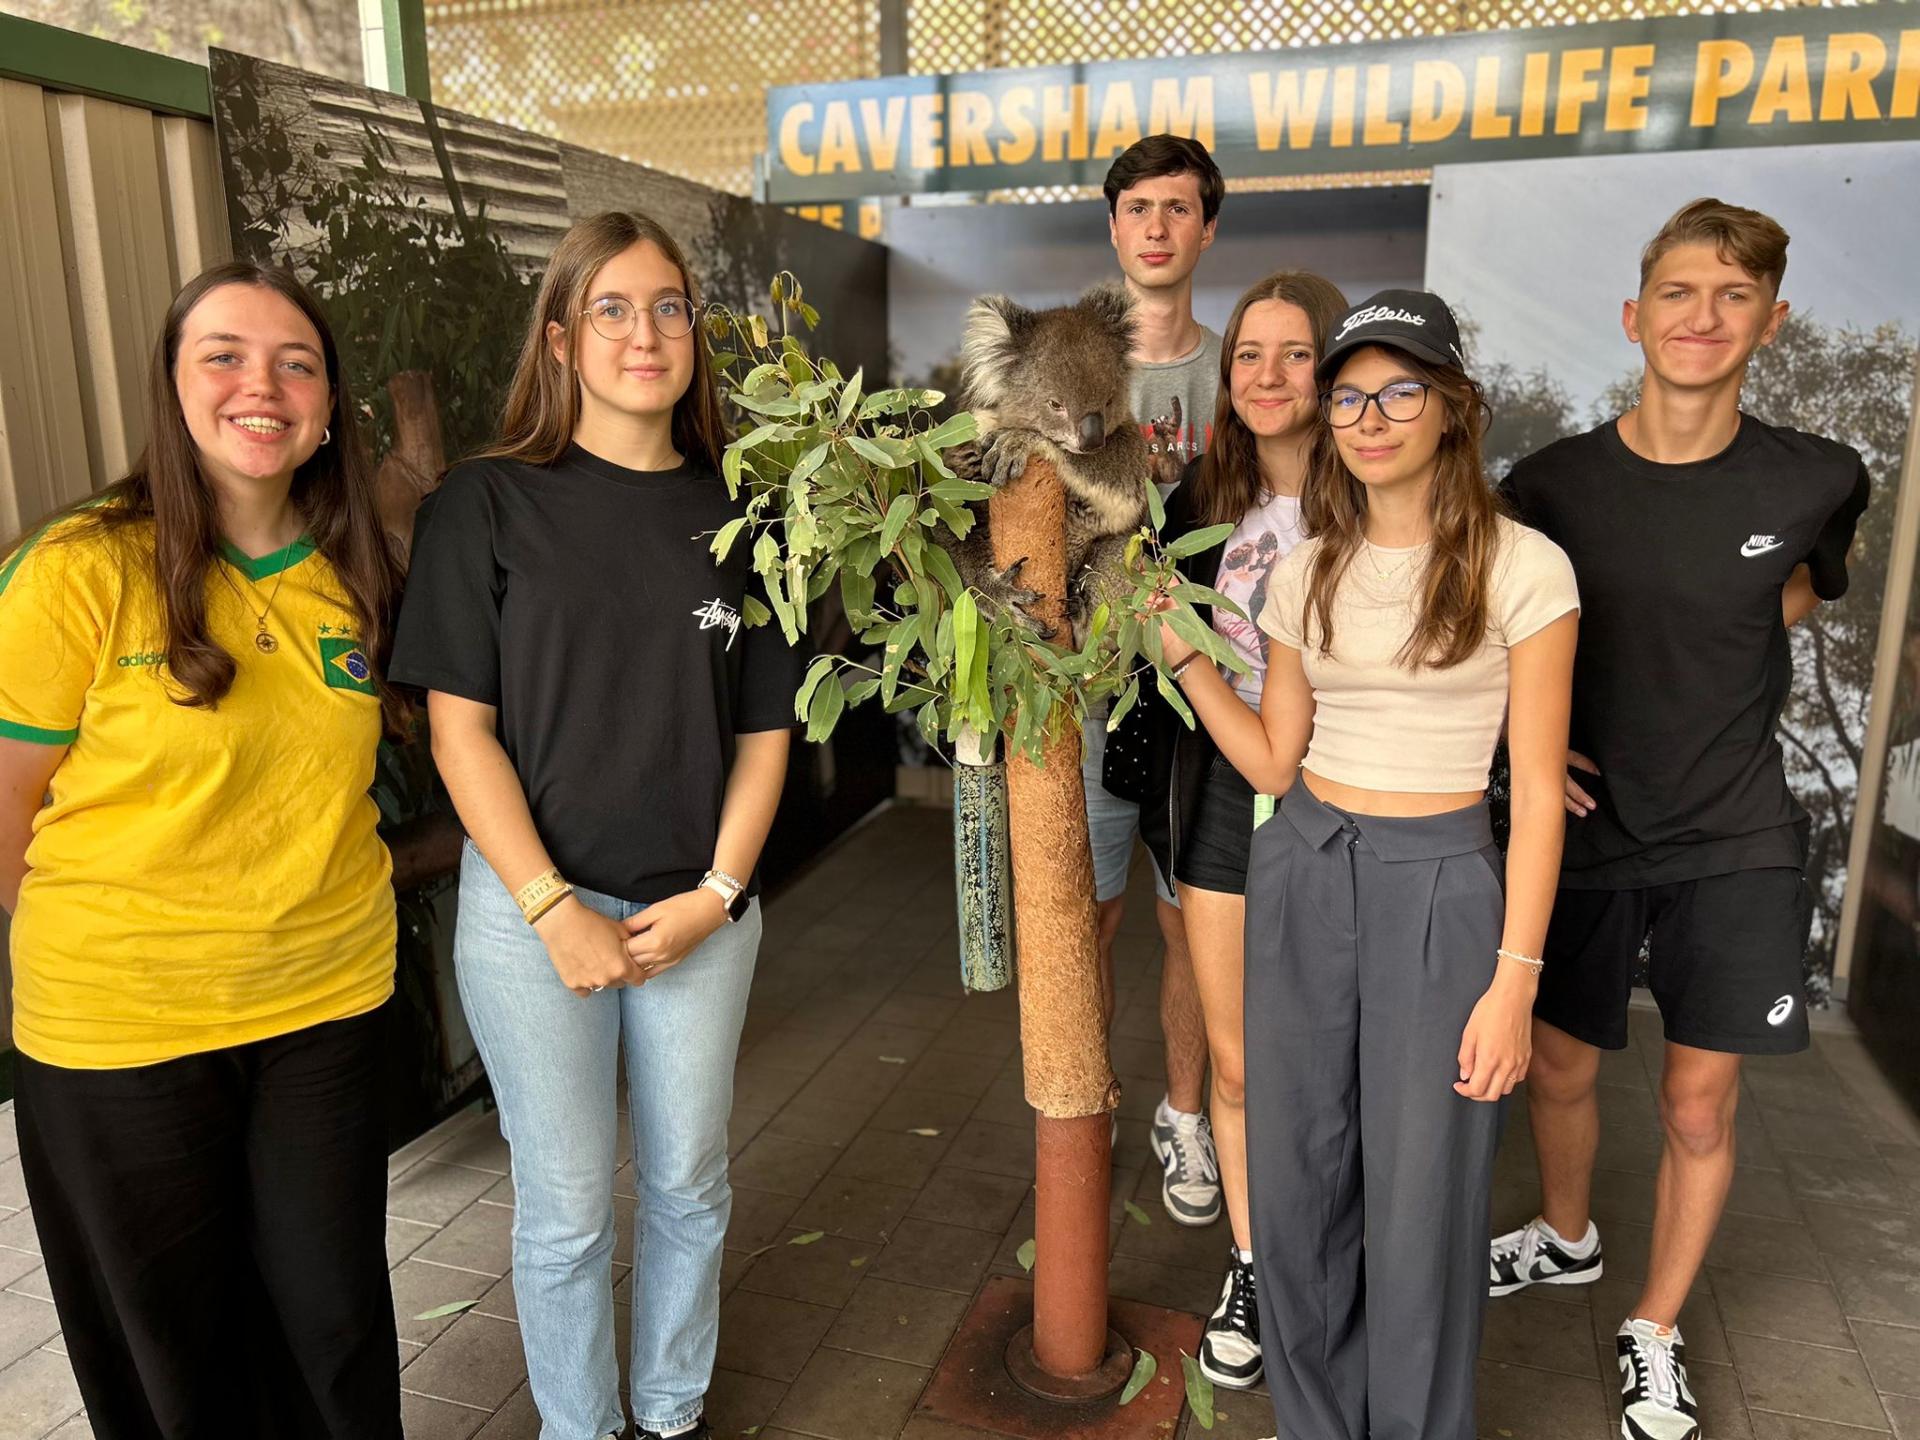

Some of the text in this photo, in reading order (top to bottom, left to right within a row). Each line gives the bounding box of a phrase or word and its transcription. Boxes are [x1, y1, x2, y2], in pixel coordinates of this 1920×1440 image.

[779, 77, 1215, 177] CAVERSHAM
[1249, 44, 1655, 152] WILDLIFE
[1335, 305, 1426, 341] Titleist
[1747, 534, 1775, 547] NIKE
[117, 651, 168, 667] adida
